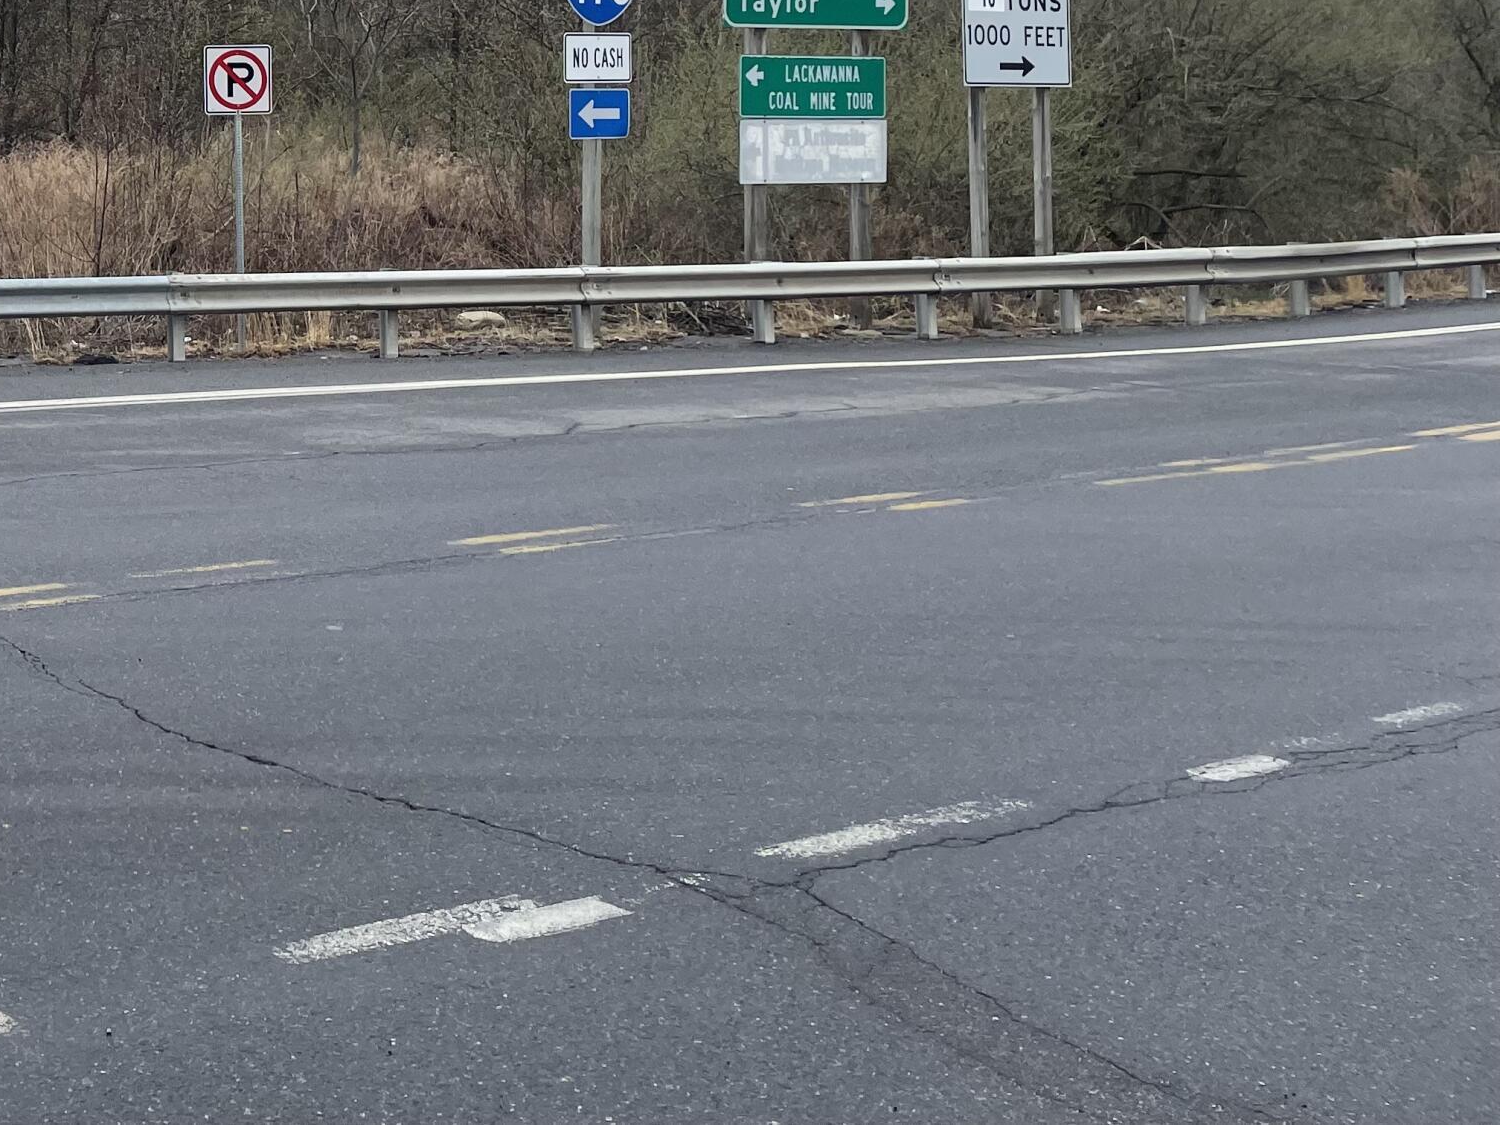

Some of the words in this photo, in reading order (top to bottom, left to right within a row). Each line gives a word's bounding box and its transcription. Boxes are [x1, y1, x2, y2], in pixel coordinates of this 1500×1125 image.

[968, 24, 1010, 46] 1000
[1024, 26, 1065, 47] FEET
[573, 48, 588, 68] NO
[594, 48, 623, 68] CASH
[785, 65, 860, 83] LACKAWANNA
[769, 92, 799, 110] COAL
[810, 92, 836, 110] MINE
[847, 93, 874, 110] TOUR
